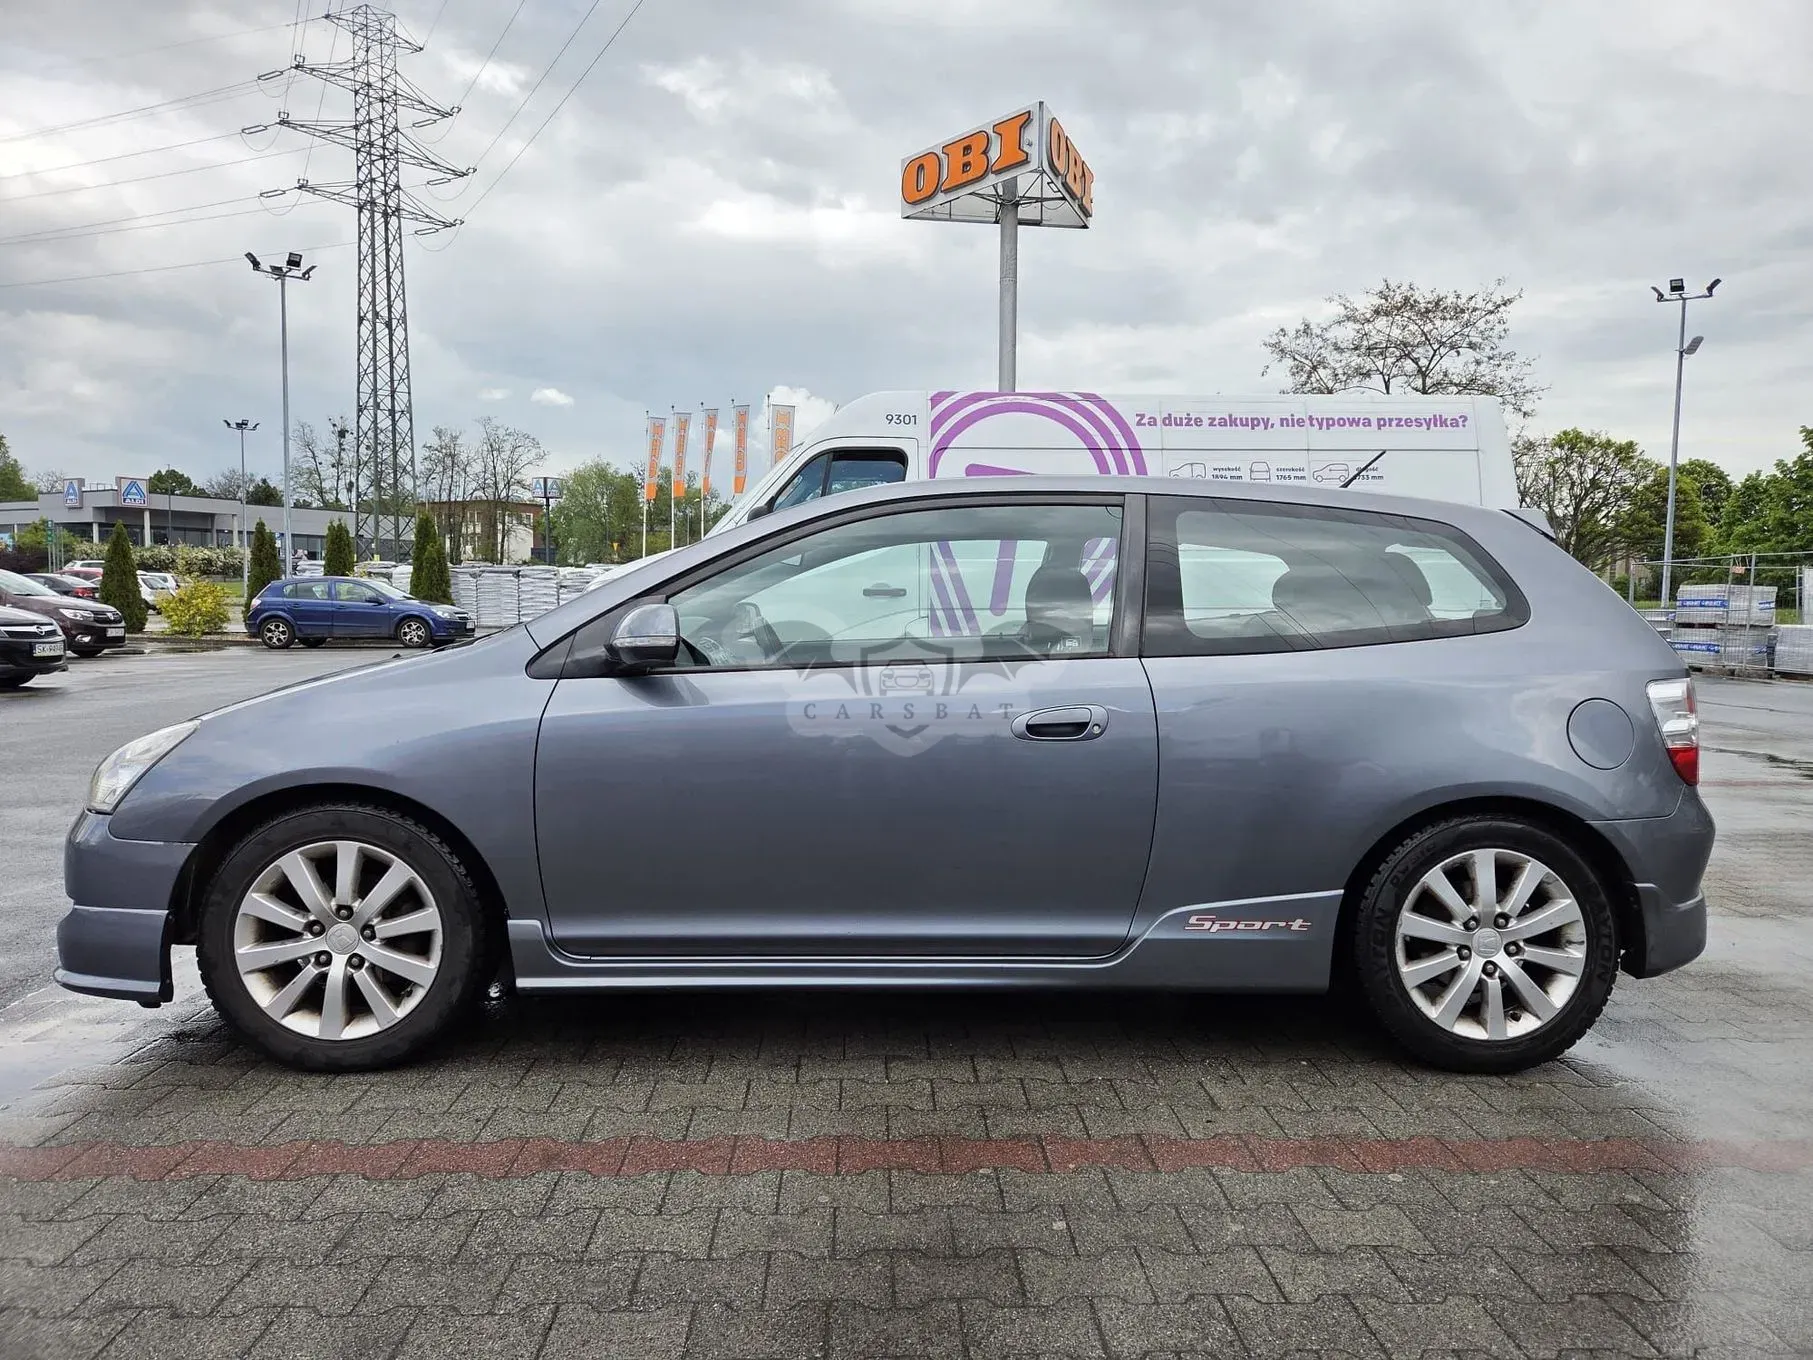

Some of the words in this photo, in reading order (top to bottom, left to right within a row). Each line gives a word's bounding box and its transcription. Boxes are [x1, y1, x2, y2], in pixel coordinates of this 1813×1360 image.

[902, 110, 1033, 205] OBI
[1048, 117, 1094, 217] OBI
[886, 414, 917, 425] 9301
[1136, 413, 1157, 427] Za
[1162, 412, 1203, 428] duże
[1208, 413, 1275, 430] zakupy,
[1377, 413, 1467, 430] przesyłka?
[1185, 915, 1311, 933] Sport
